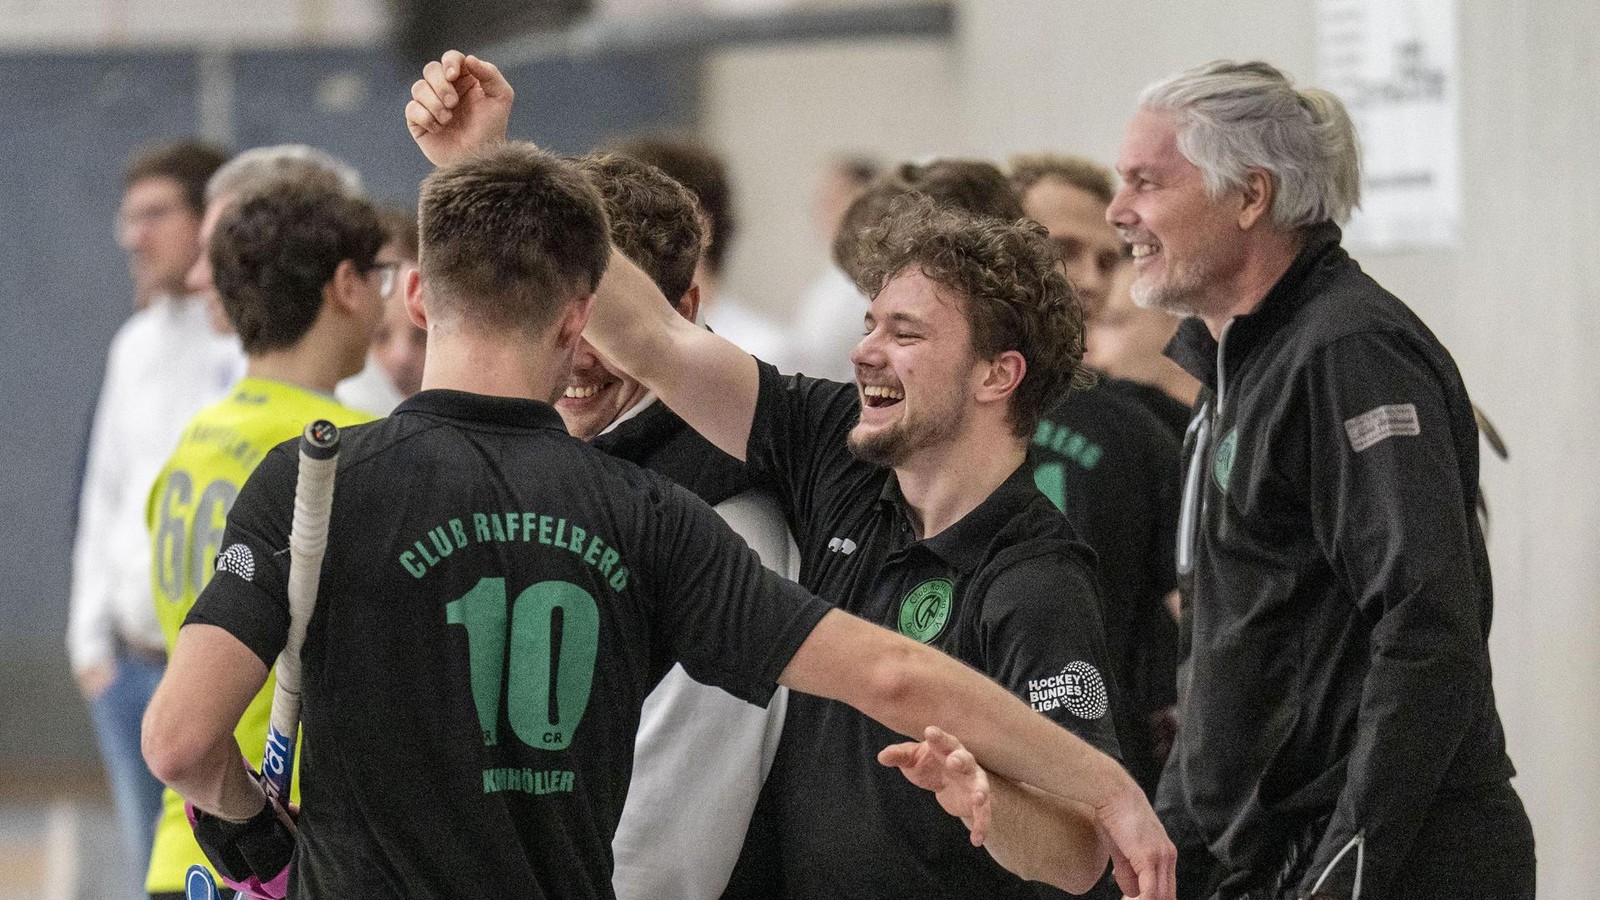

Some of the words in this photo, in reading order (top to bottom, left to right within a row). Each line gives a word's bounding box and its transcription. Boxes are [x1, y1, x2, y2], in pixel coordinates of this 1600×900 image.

[398, 517, 469, 580] CLUB
[446, 577, 600, 751] 10
[1029, 685, 1082, 703] BUNDES
[1031, 698, 1061, 713] LIGA
[542, 732, 563, 744] CR
